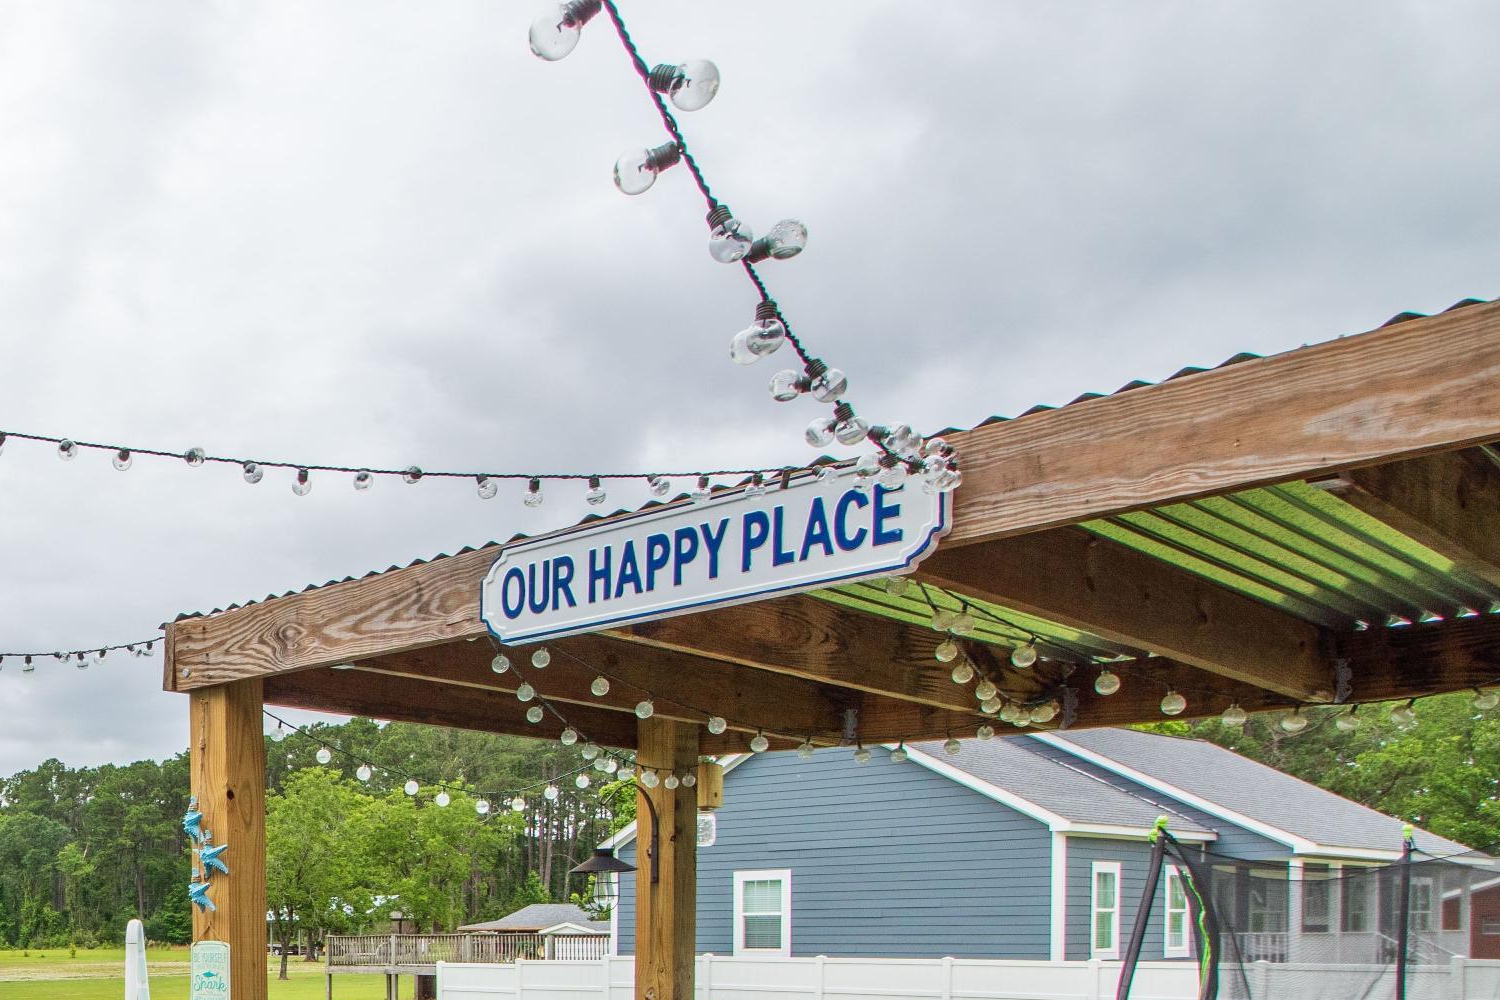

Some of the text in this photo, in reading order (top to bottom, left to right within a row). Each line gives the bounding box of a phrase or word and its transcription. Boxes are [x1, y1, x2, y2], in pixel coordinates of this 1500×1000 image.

[501, 482, 905, 620] OUR HAPPY PLACE
[193, 974, 228, 992] Shark
